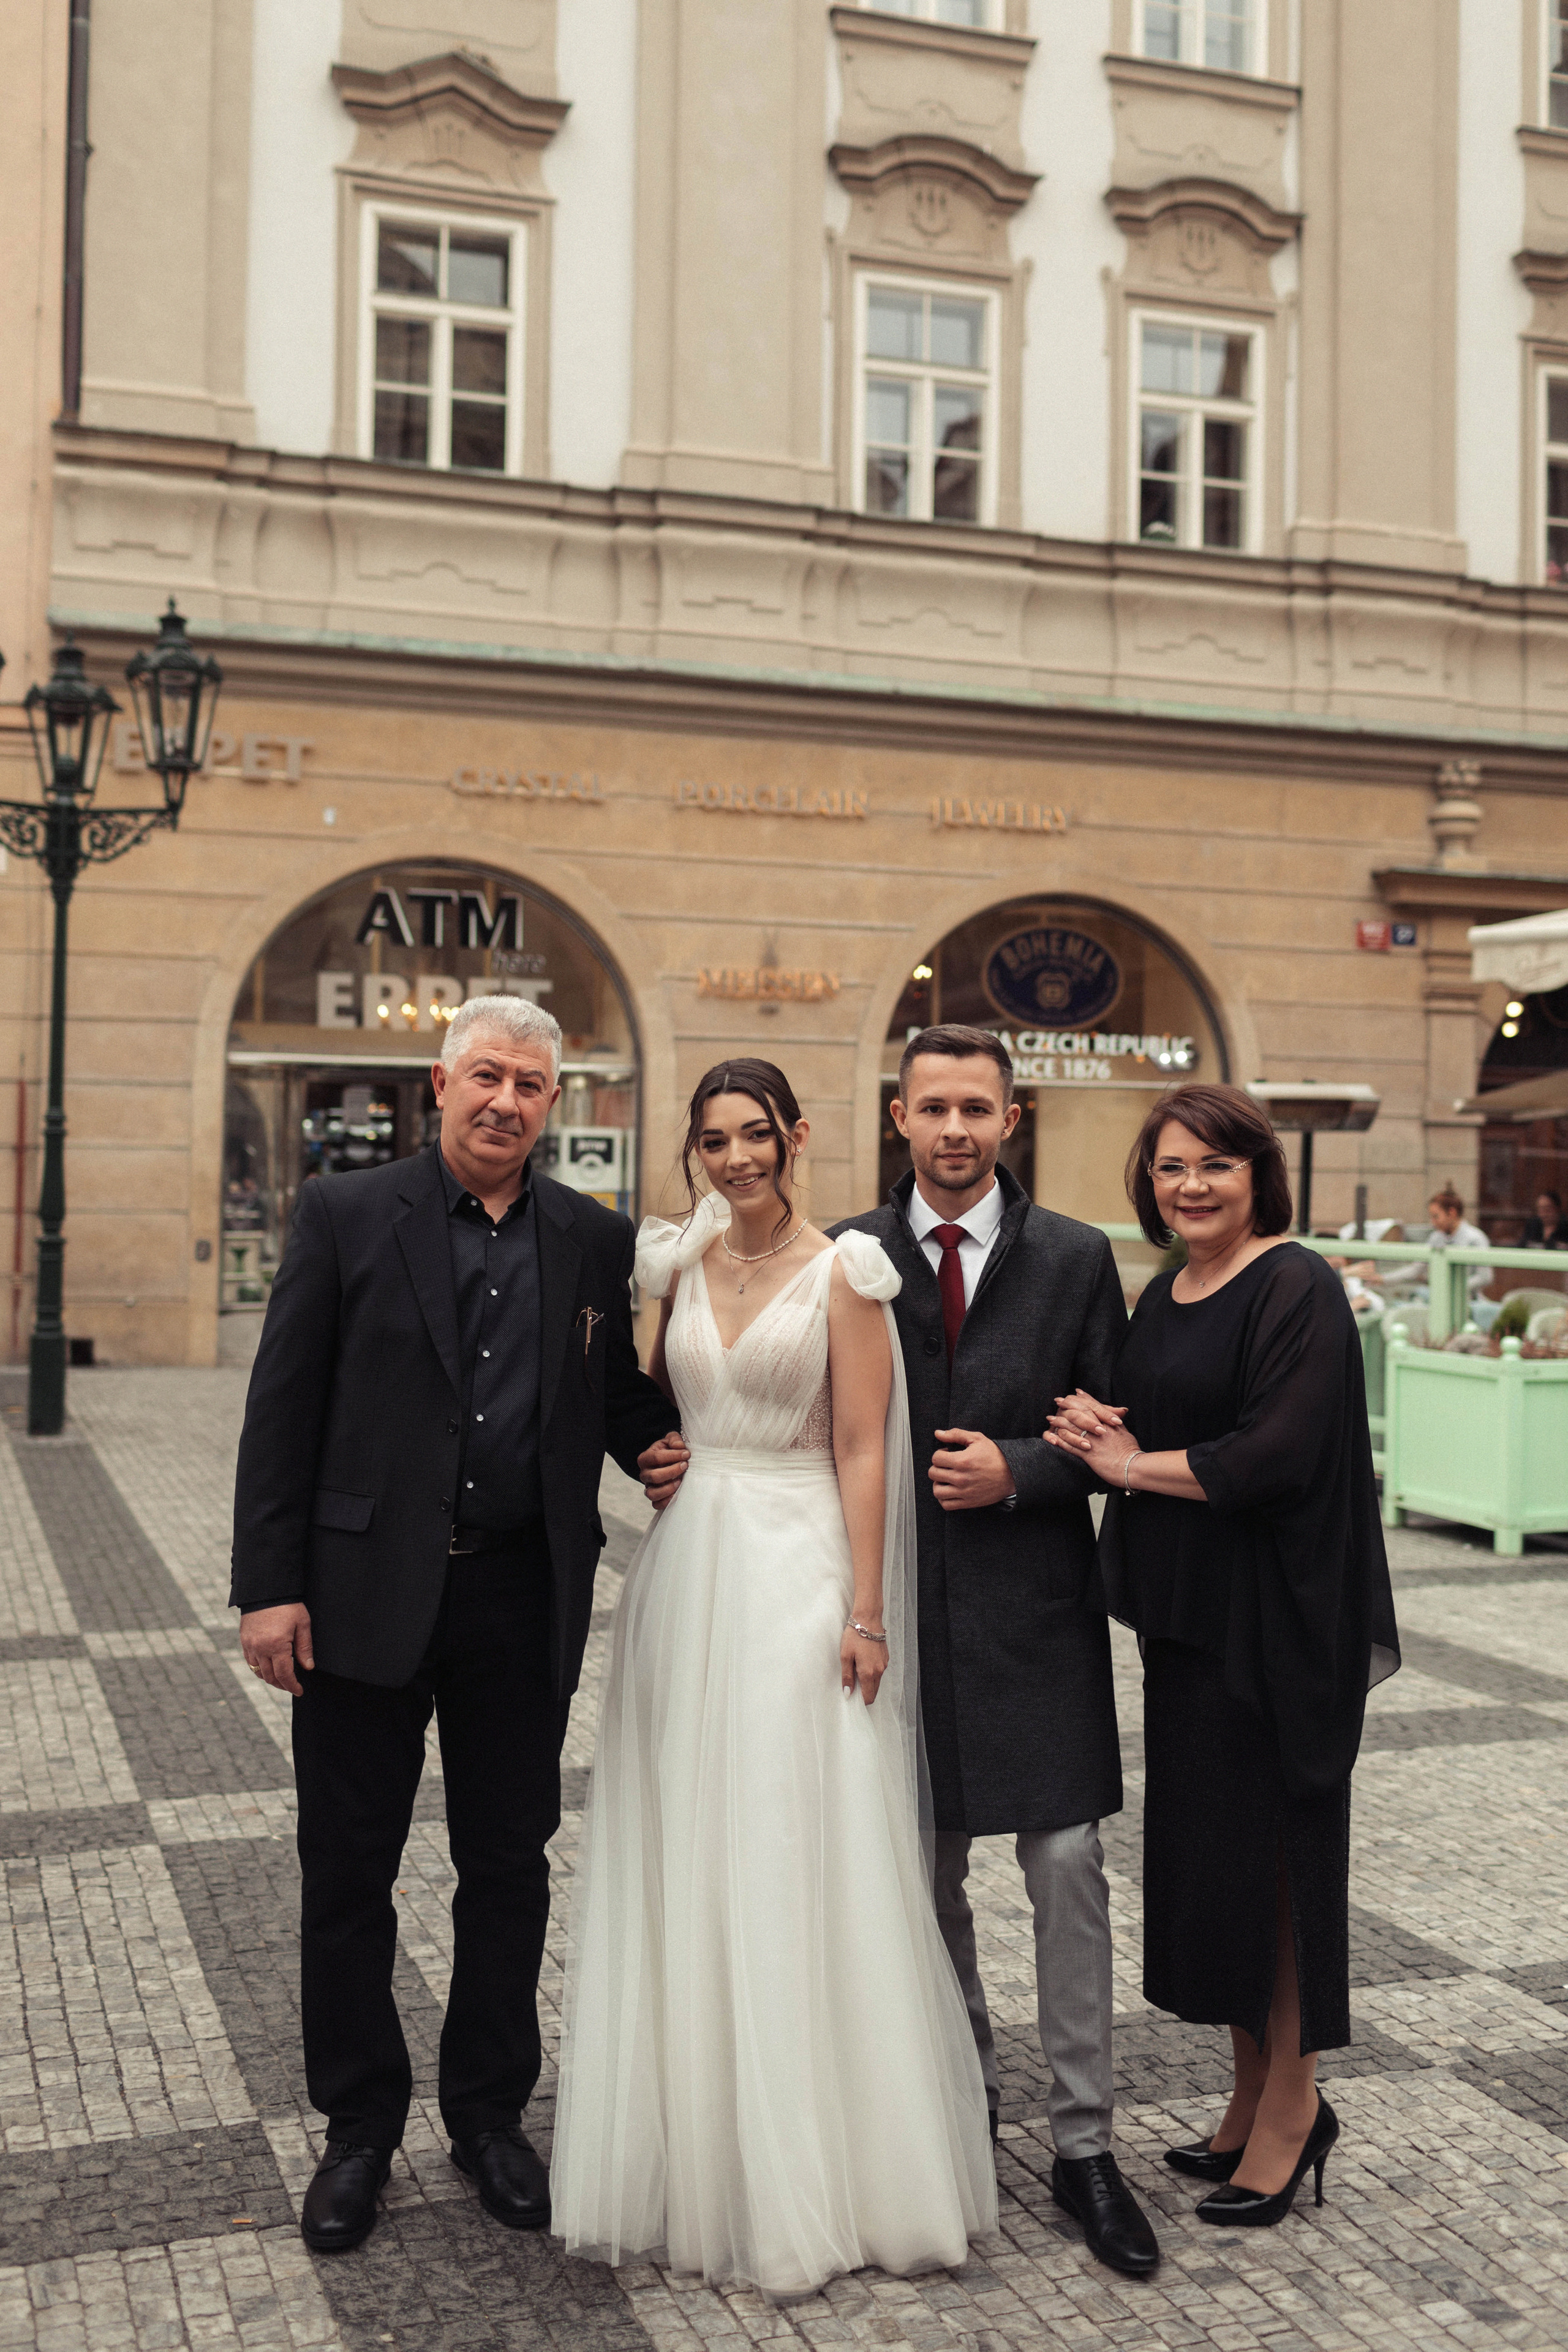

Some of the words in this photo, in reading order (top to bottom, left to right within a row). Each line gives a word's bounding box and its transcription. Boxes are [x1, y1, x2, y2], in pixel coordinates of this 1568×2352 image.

[454, 766, 604, 800] CRYSTAL
[677, 780, 870, 816] PORCELAIN
[356, 886, 524, 950] ATM
[492, 949, 547, 973] here
[1001, 932, 1105, 973] BOHEMIA
[1017, 1030, 1090, 1054] CZECH
[1093, 1033, 1194, 1061] REPUBLIC
[1011, 1057, 1057, 1077] NCE
[1062, 1058, 1112, 1079] 1876
